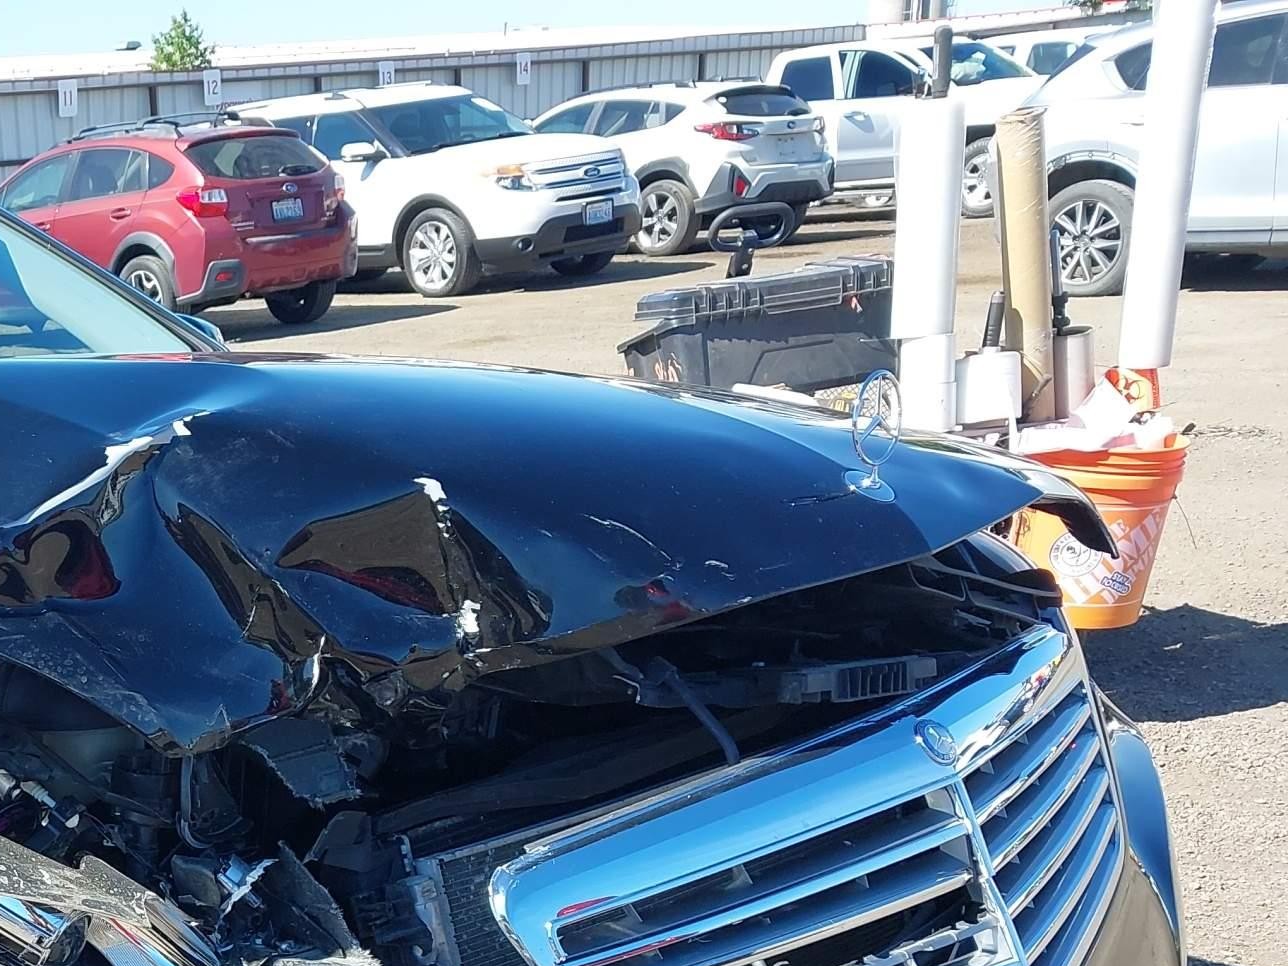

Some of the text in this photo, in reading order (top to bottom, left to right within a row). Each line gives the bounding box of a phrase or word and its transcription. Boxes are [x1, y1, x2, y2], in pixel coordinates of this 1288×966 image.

[519, 61, 528, 75] 14
[382, 71, 392, 85] 13
[207, 80, 219, 96] 12
[63, 90, 73, 107] 11
